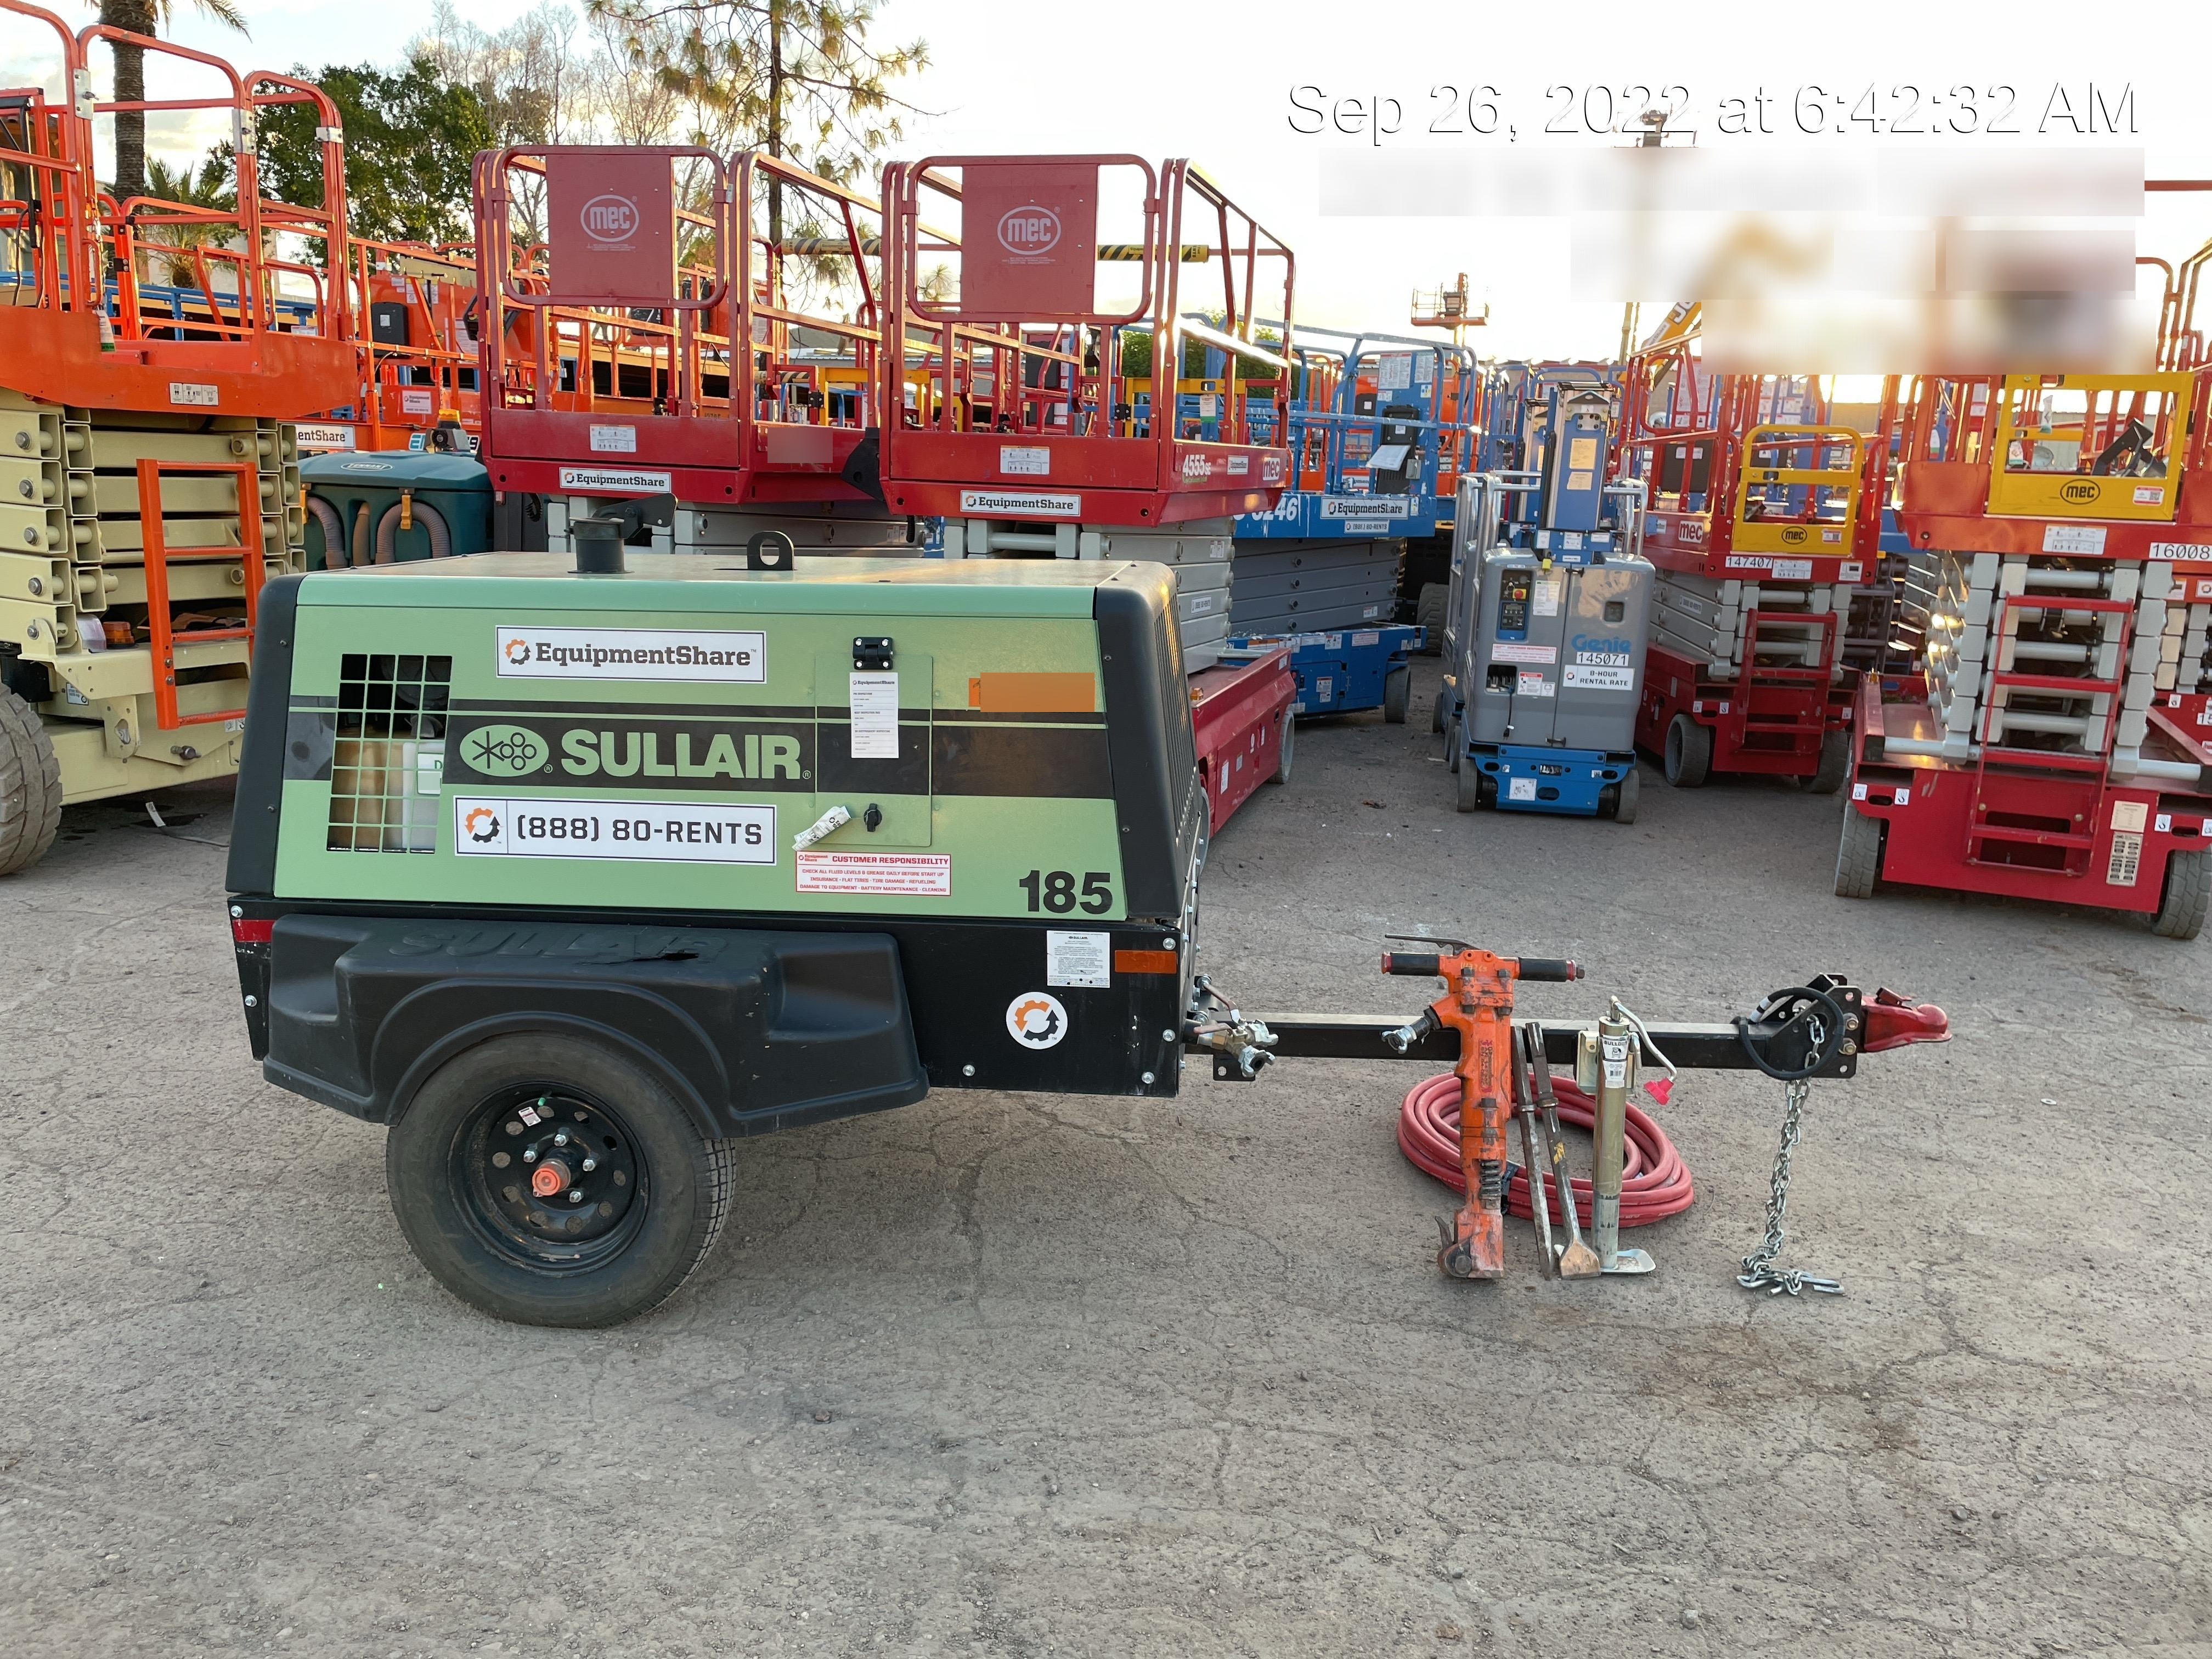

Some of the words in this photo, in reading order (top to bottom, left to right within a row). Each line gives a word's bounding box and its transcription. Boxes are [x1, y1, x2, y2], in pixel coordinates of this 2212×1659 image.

[590, 206, 630, 229] mec
[1007, 217, 1052, 242] mec
[296, 430, 346, 442] entShare
[1263, 460, 1280, 478] mec
[576, 473, 665, 487] EquipmentShare
[2066, 486, 2095, 498] mec
[978, 496, 1074, 510] EquipmentShare
[1679, 522, 1702, 541] mec
[1785, 531, 1804, 540] mec
[1727, 557, 1772, 567] 147407
[1571, 634, 1632, 653] Genie
[535, 642, 751, 668] EquipmentShare
[1578, 653, 1627, 665] 145071
[1580, 678, 1607, 686] RENTAL
[561, 729, 801, 780] SULLAIR
[517, 814, 599, 842] (888)
[612, 819, 762, 845] 80-RENTS
[832, 855, 877, 864] CUSTOMER
[879, 856, 949, 865] RESPONSIBILITY
[1019, 870, 1113, 915] 185
